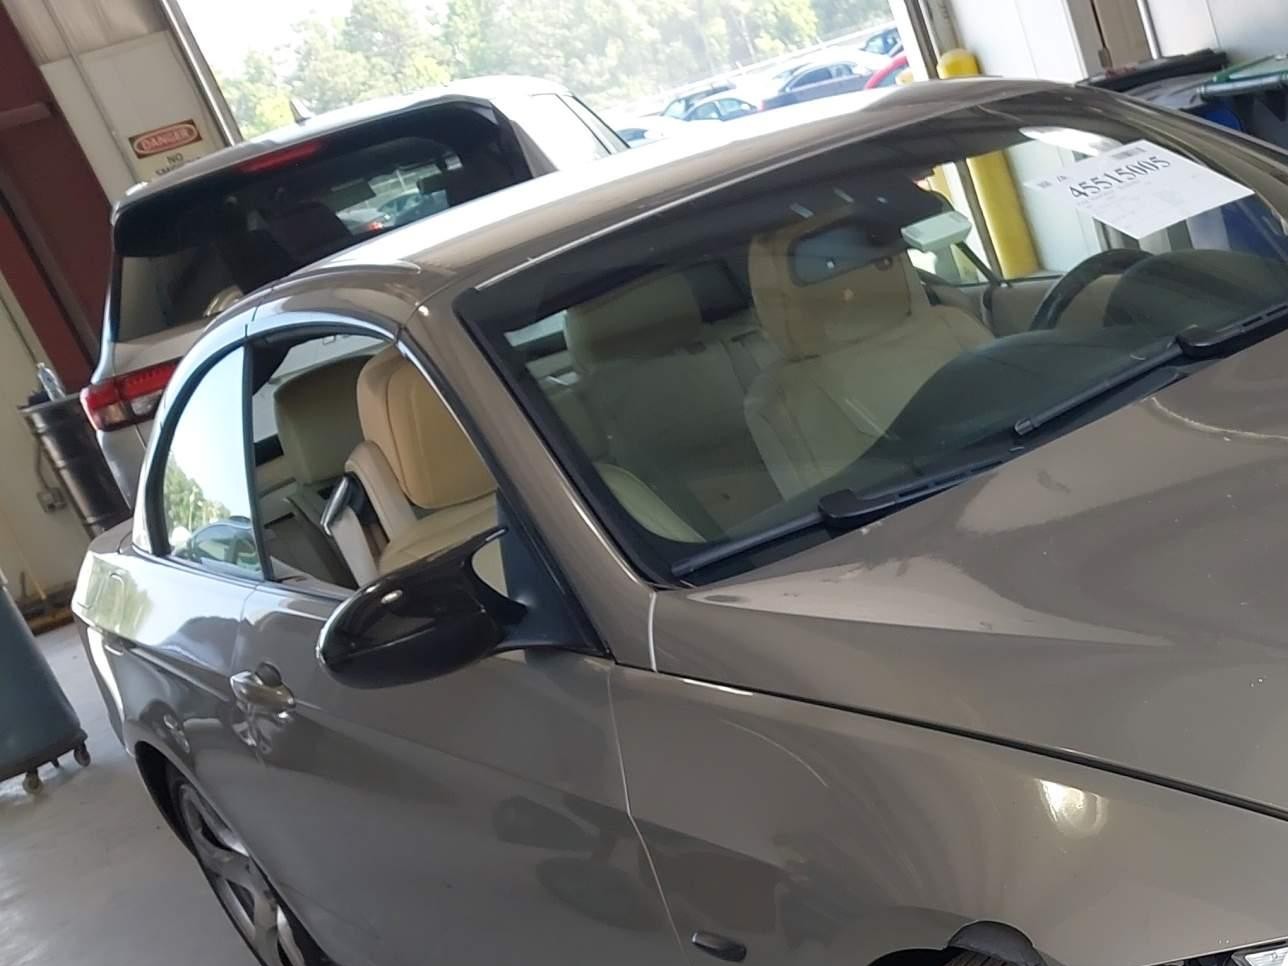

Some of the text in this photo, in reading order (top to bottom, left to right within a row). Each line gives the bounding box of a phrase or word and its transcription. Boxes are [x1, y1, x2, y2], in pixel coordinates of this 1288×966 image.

[141, 128, 190, 151] DANGER
[166, 153, 184, 164] NO
[1068, 156, 1171, 200] 45515005
